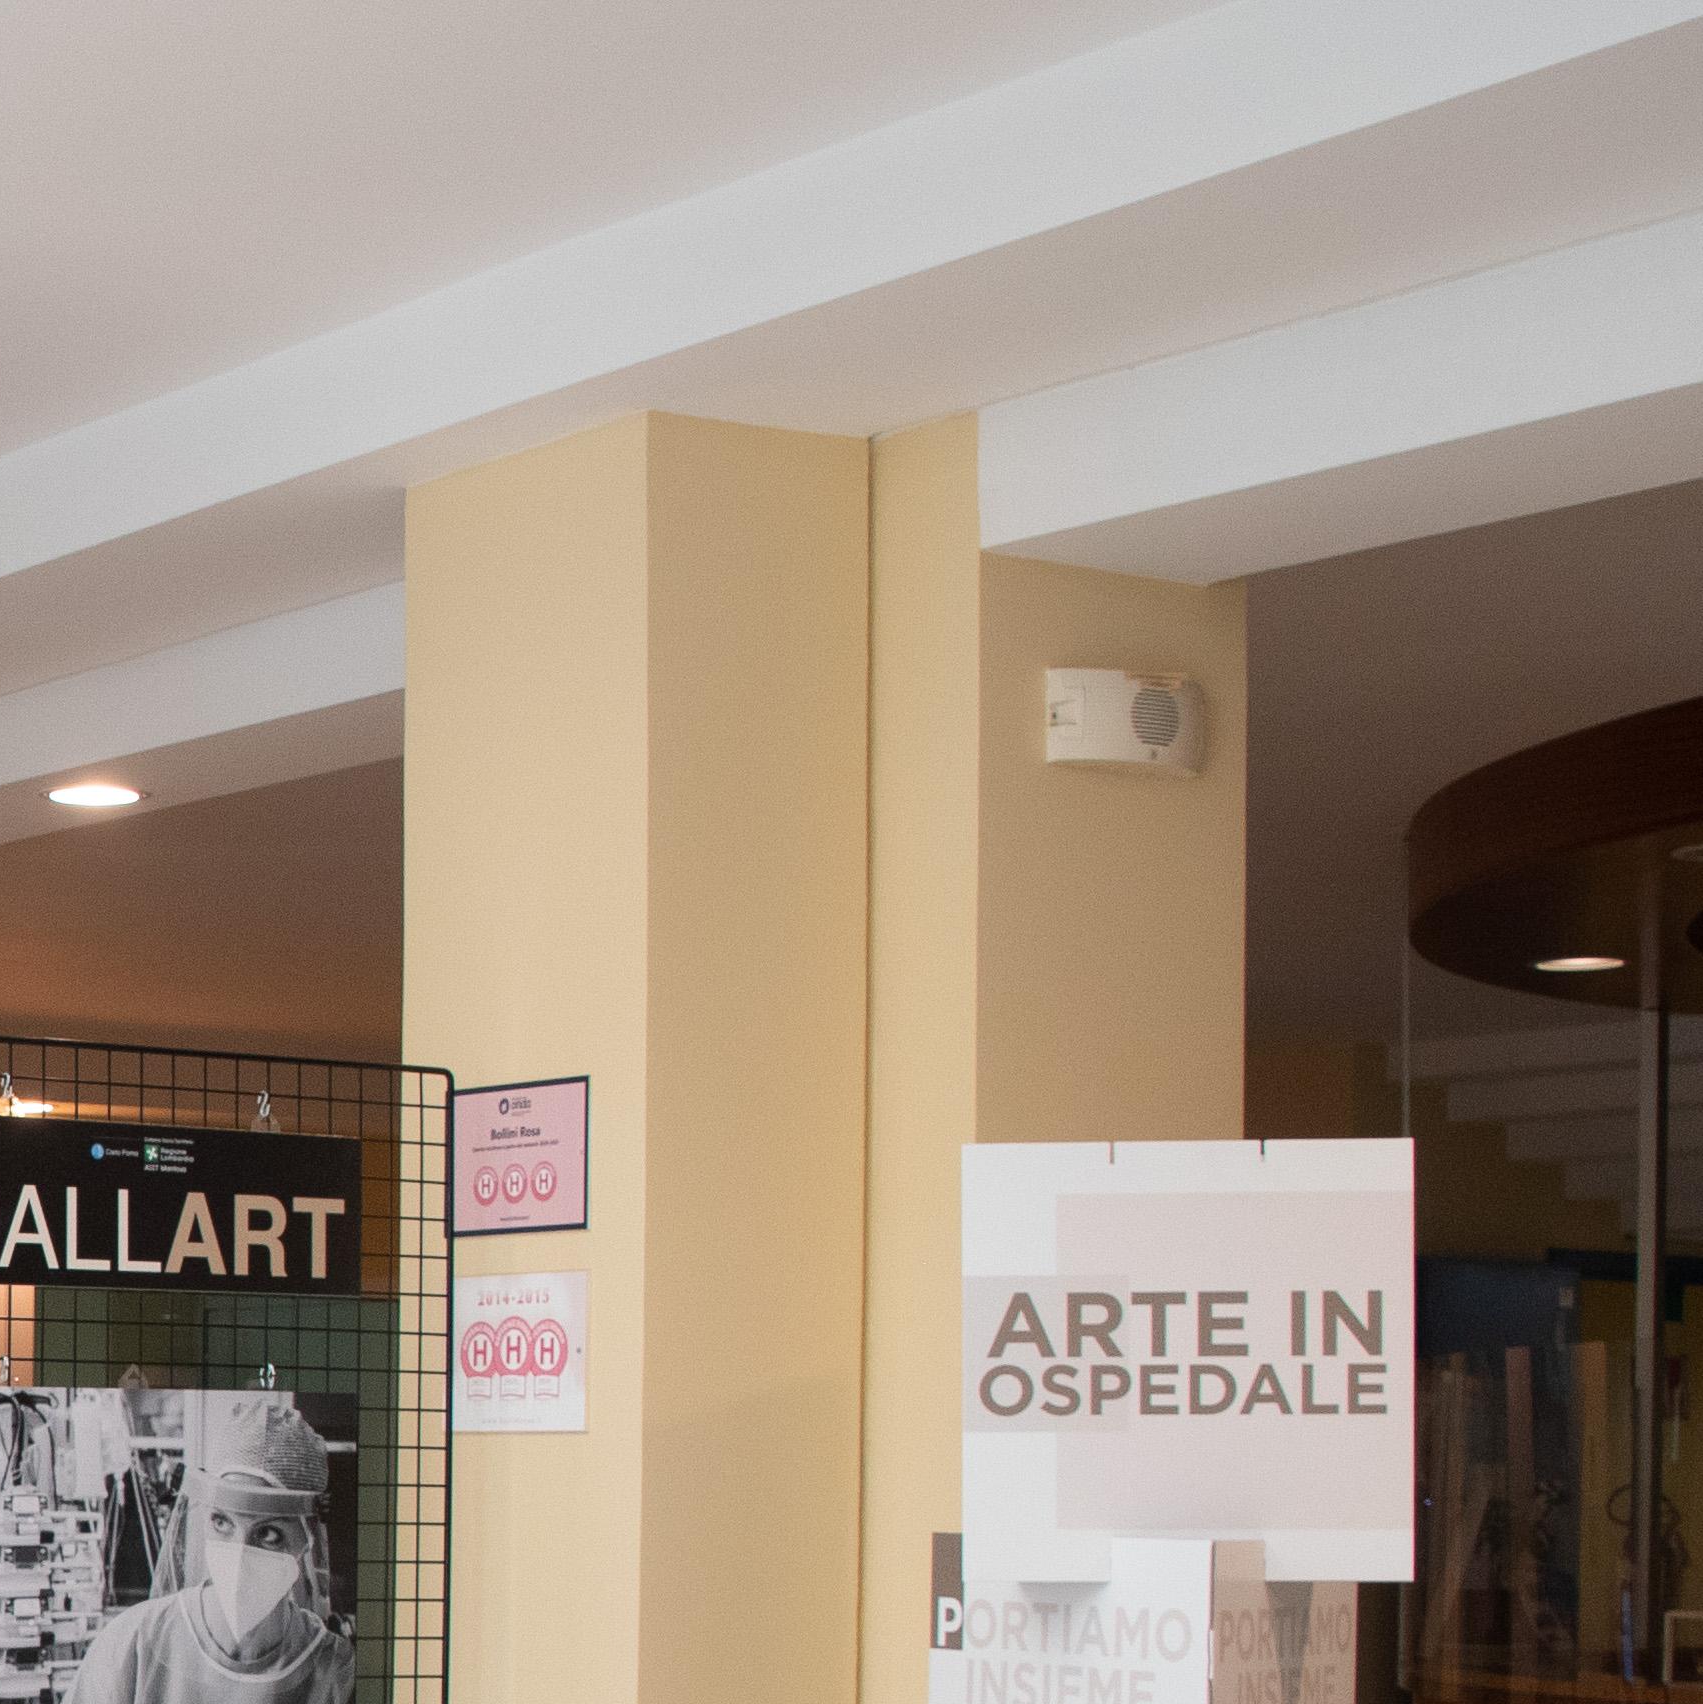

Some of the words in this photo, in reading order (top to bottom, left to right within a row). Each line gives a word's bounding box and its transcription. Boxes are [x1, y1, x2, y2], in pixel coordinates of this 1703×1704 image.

[987, 1291, 1249, 1358] ARTE
[1291, 1290, 1383, 1357] IN
[979, 1363, 1388, 1417] OSPEDALE
